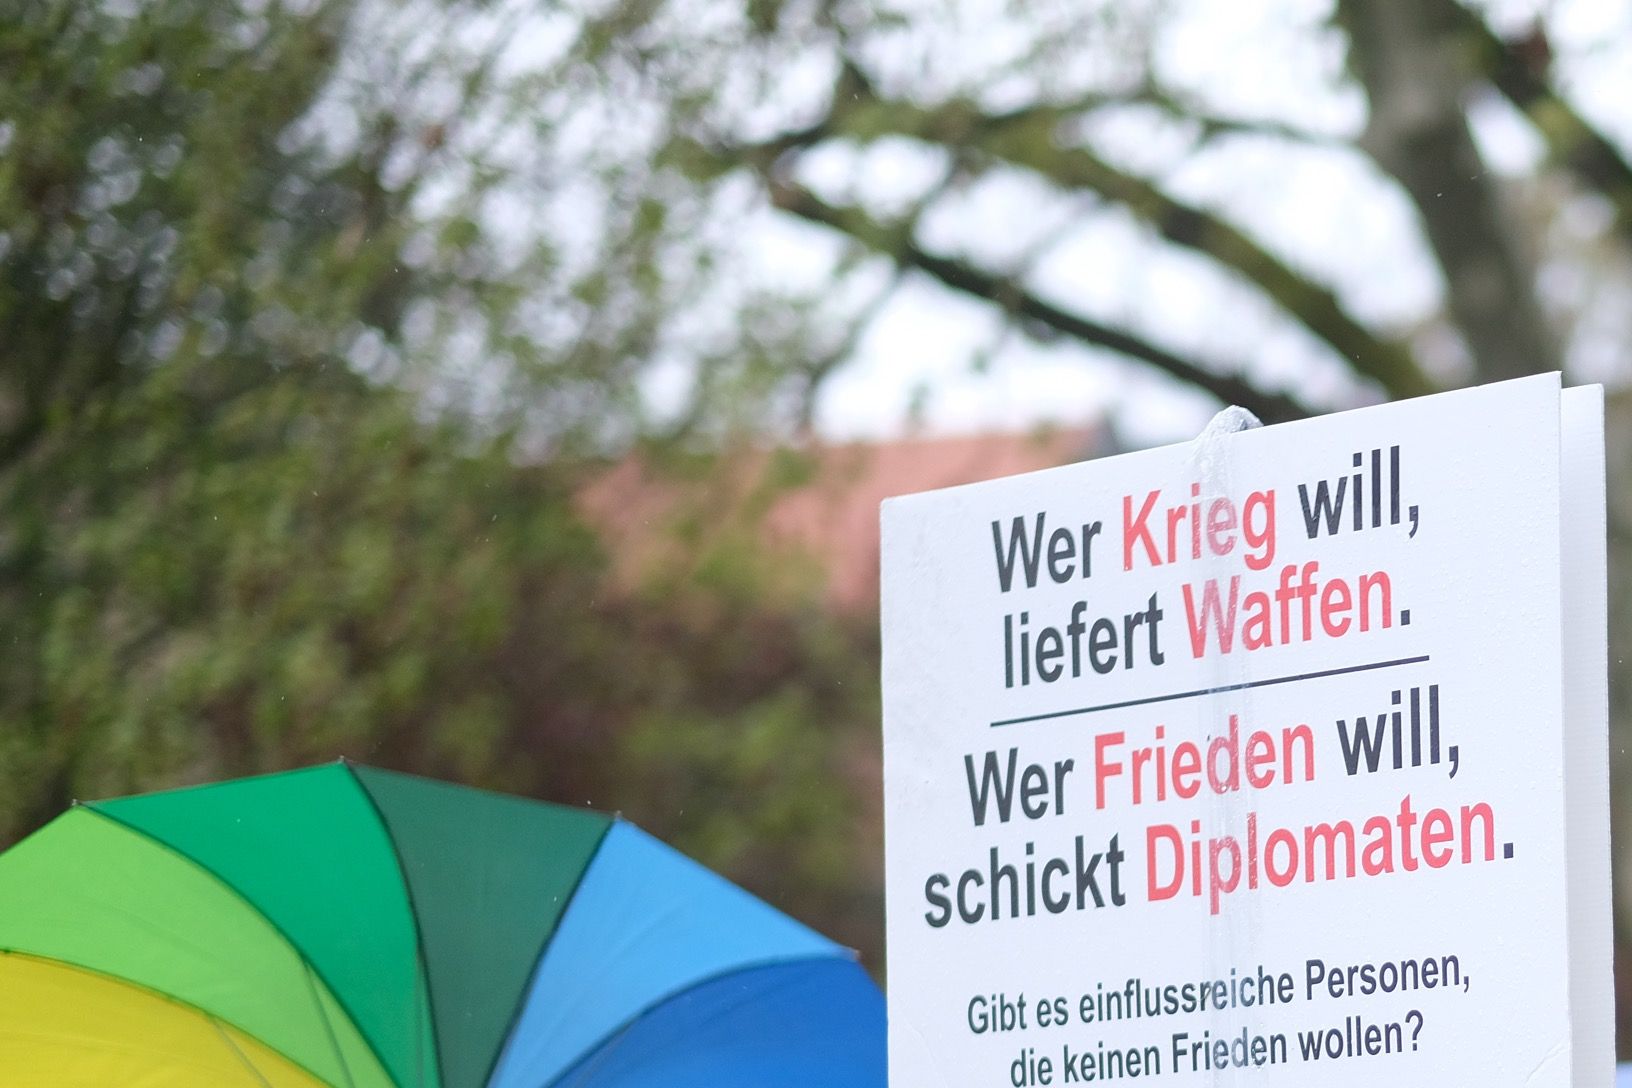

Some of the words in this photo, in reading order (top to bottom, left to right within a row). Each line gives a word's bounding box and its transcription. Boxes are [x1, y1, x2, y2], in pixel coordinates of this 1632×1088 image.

[992, 512, 1101, 593] Wer
[1122, 483, 1276, 572] Krieg
[1297, 445, 1419, 539] will,
[1004, 593, 1164, 688] liefert
[1182, 561, 1411, 659] Waffen.
[965, 747, 1075, 826] Wer
[1095, 715, 1314, 809] Frieden
[1337, 685, 1460, 779] will,
[924, 832, 1125, 929] schickt
[1146, 794, 1514, 915] Diplomaten.
[967, 991, 1027, 1034] Gibt
[1037, 998, 1068, 1028] es
[1079, 965, 1294, 1024] einflussreiche
[1306, 954, 1470, 1002] Personen,
[1010, 1048, 1052, 1088] die
[1064, 1036, 1160, 1082] keinen
[1172, 1026, 1287, 1073] Frieden
[1298, 1010, 1423, 1060] wollen?
